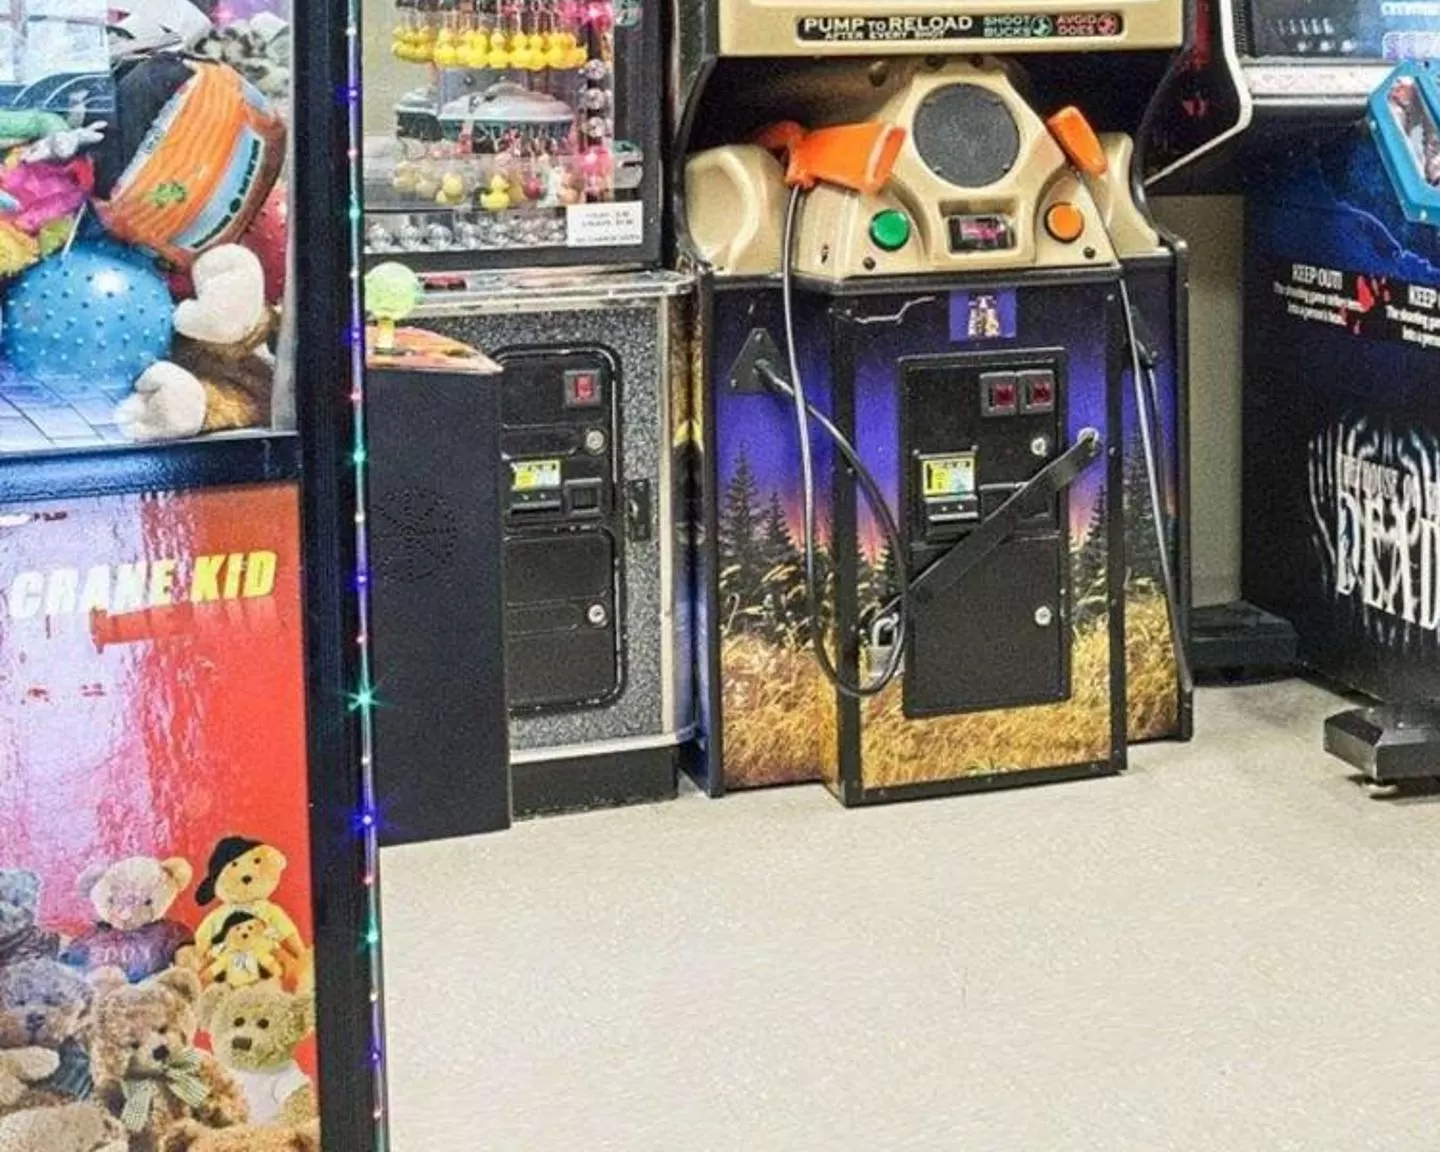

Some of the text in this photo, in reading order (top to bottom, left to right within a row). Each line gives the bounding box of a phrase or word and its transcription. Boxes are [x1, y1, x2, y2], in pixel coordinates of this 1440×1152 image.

[804, 16, 865, 33] PUMP
[888, 16, 973, 32] RELOAD
[983, 15, 1031, 26] SHOOT
[983, 26, 1031, 37] BUCKS
[1291, 263, 1317, 284] KEEP
[1408, 284, 1437, 309] KEEP
[8, 550, 278, 618] CRANE KID
